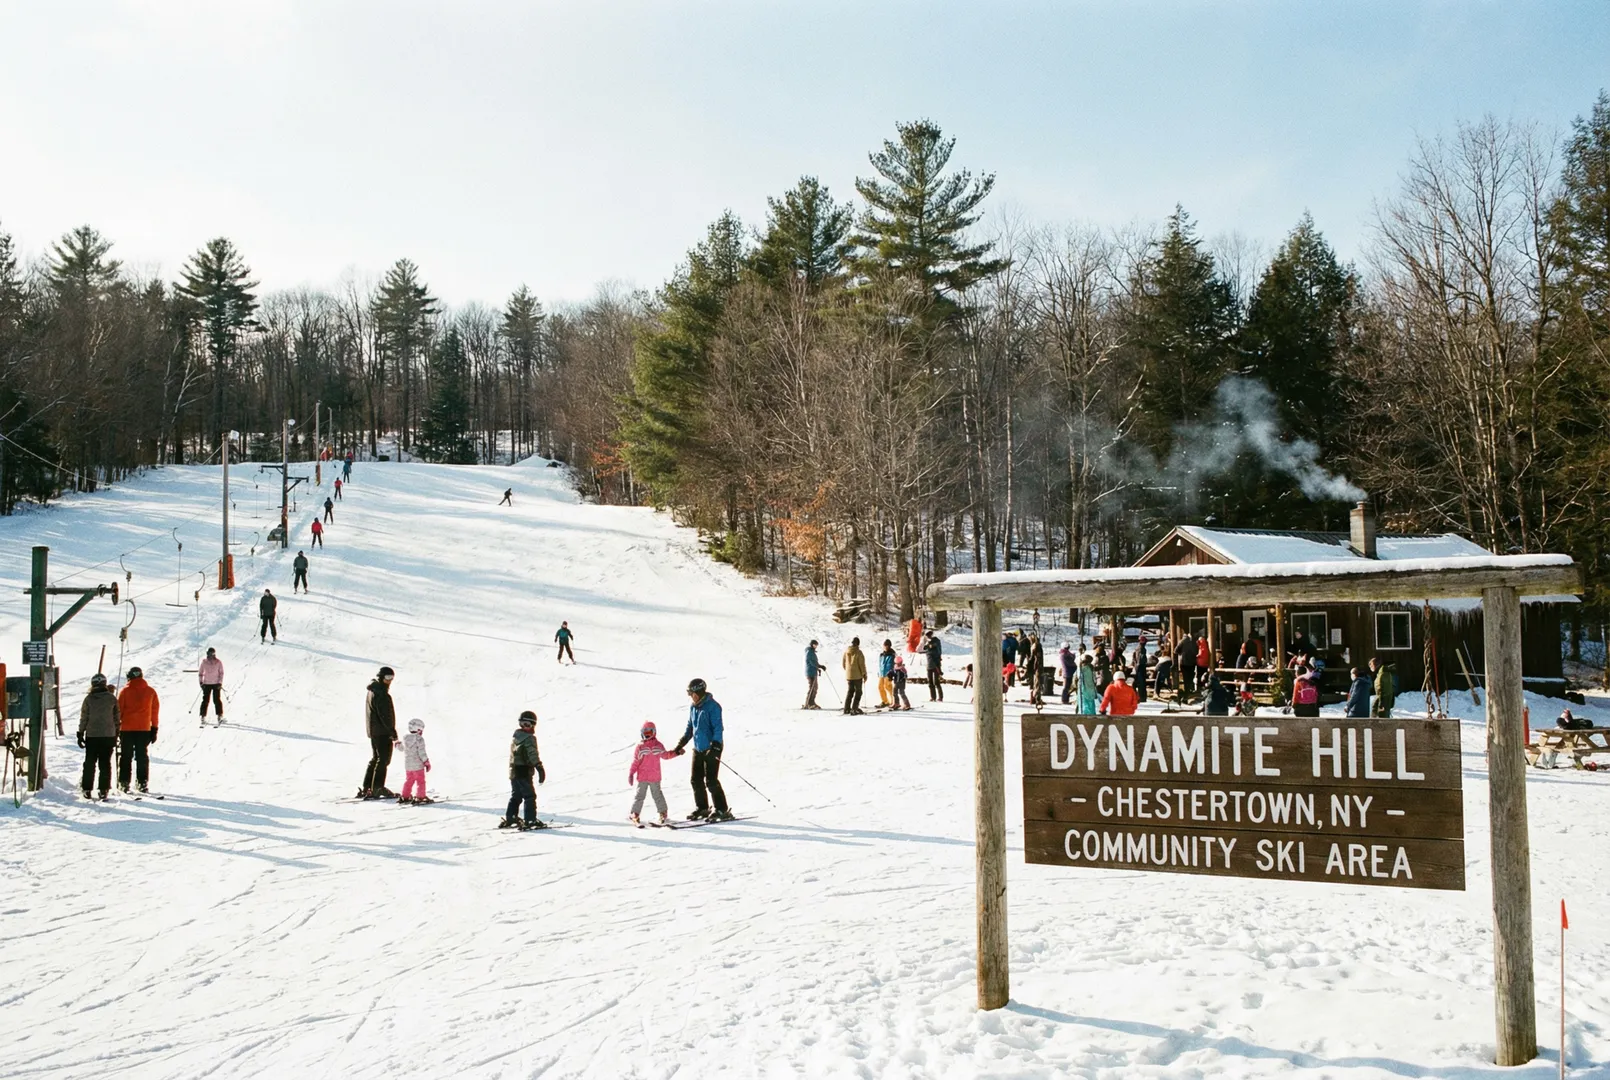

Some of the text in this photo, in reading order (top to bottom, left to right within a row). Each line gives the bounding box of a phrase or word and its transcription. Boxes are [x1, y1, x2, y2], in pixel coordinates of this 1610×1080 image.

[1049, 723, 1426, 781] DYNAMITE HILL
[1097, 785, 1323, 830] CHESTERTOWN,
[1330, 793, 1373, 828] NY
[1064, 829, 1413, 880] COMMUNITY SKI AREA
